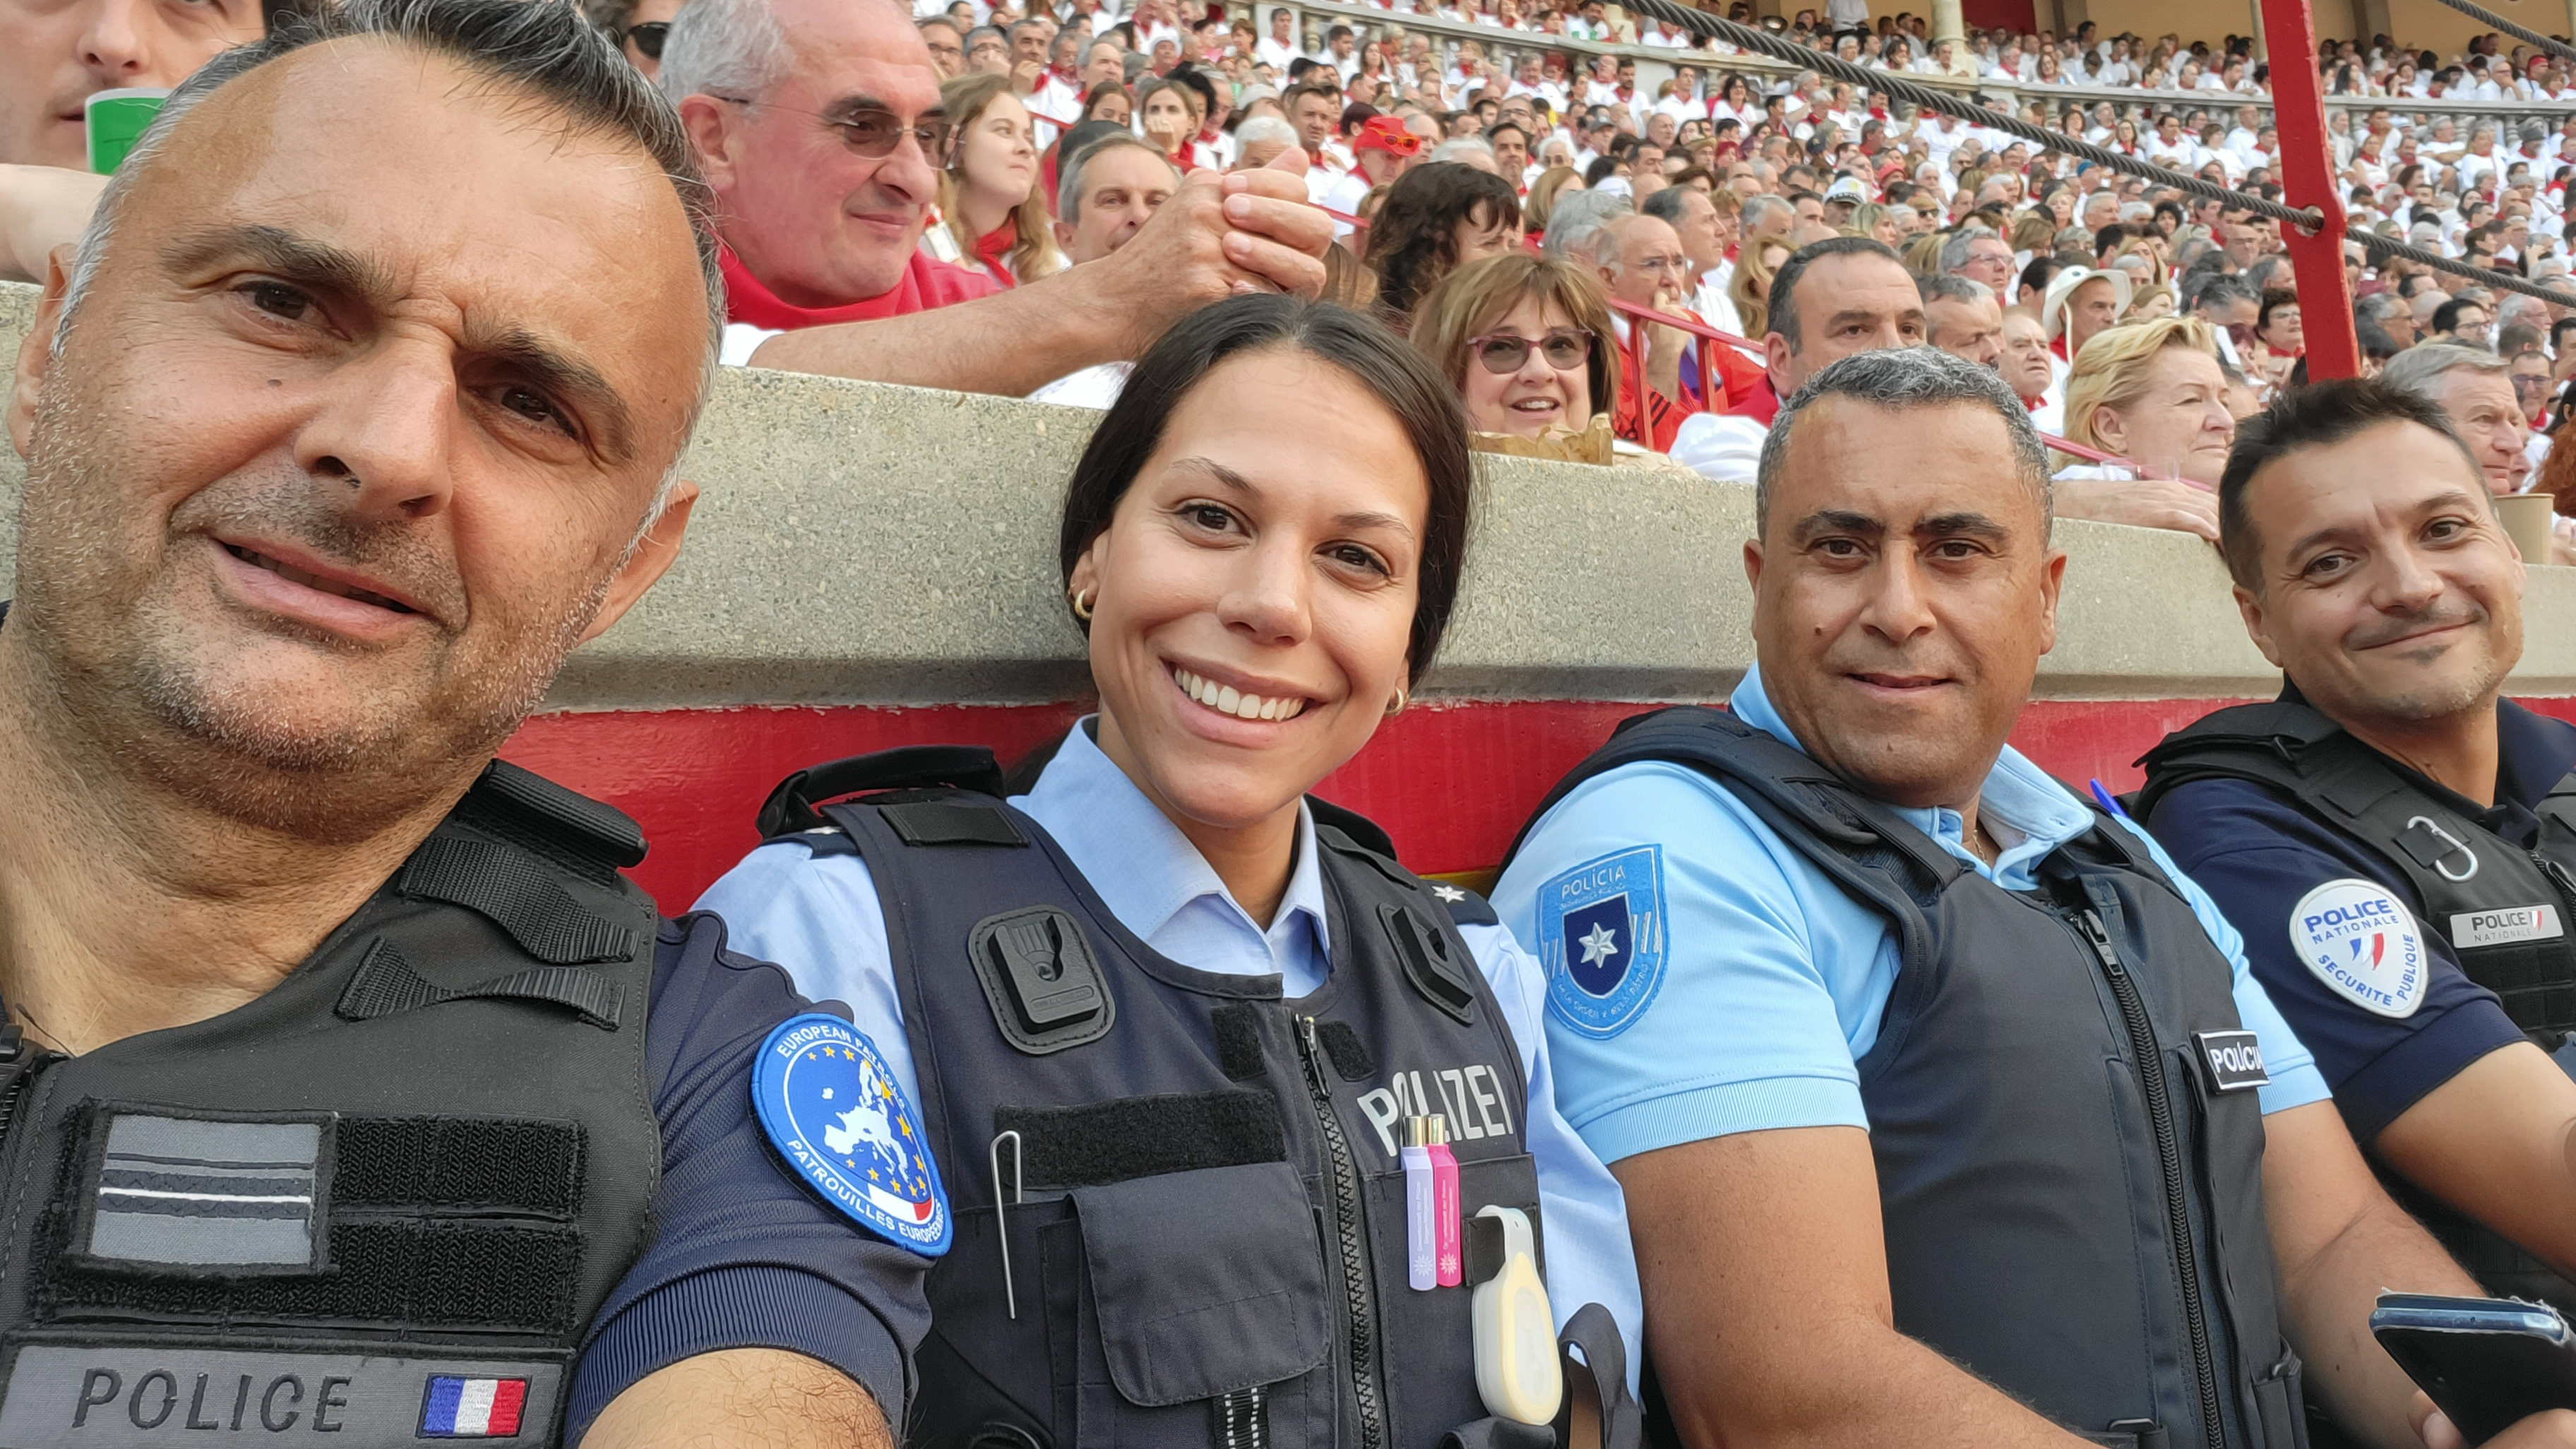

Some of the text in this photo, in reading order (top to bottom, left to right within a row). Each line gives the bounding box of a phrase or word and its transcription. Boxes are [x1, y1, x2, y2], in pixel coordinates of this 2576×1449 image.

[2304, 899, 2393, 933] POLICE
[2312, 915, 2399, 945] NATIONALE
[2471, 912, 2528, 931] POLICE
[2474, 929, 2532, 942] NATIONALE
[2318, 934, 2416, 1006] SECURITE PUBLIQUE
[777, 1025, 852, 1059] EUROPEAN
[1356, 1065, 1513, 1157] POLIZEI
[787, 1140, 895, 1230] PATROUILLES
[72, 1367, 352, 1433] POLICE
